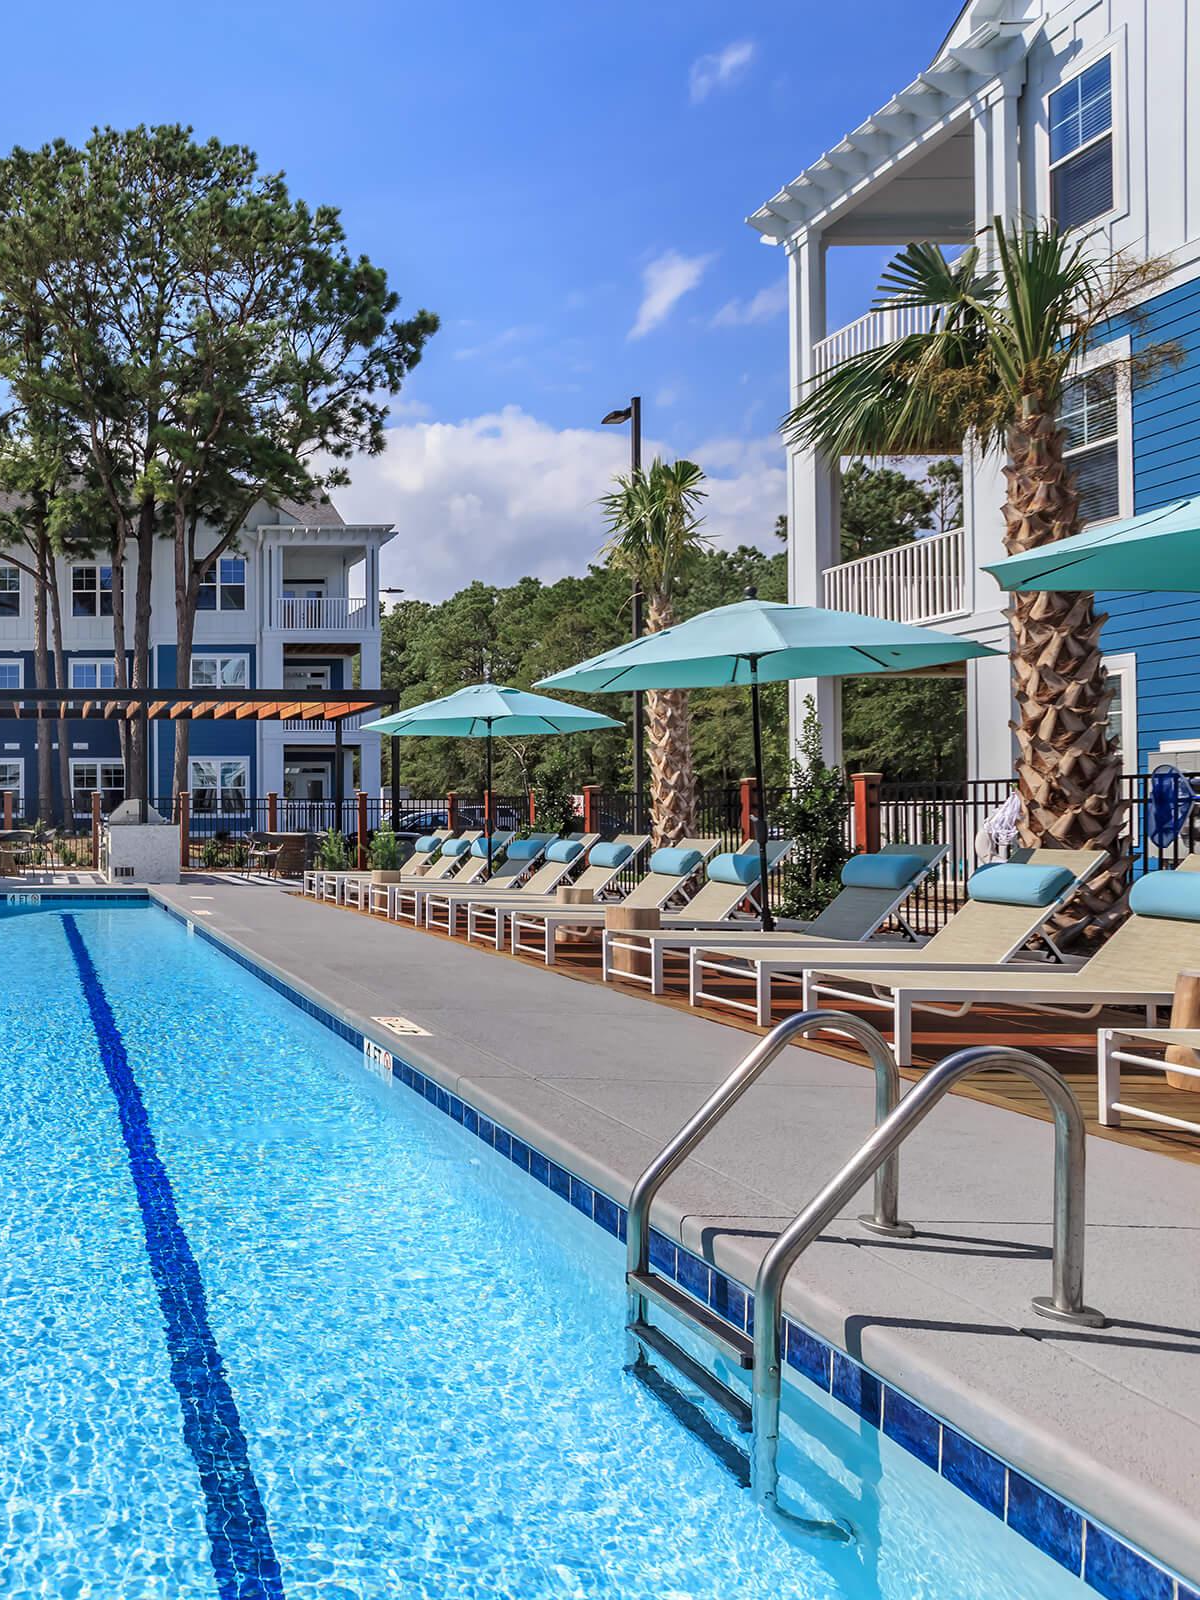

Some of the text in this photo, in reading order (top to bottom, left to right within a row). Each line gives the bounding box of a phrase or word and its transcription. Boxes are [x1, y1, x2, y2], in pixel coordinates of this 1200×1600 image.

[19, 894, 29, 904] FT
[366, 1041, 382, 1065] 4 FT
